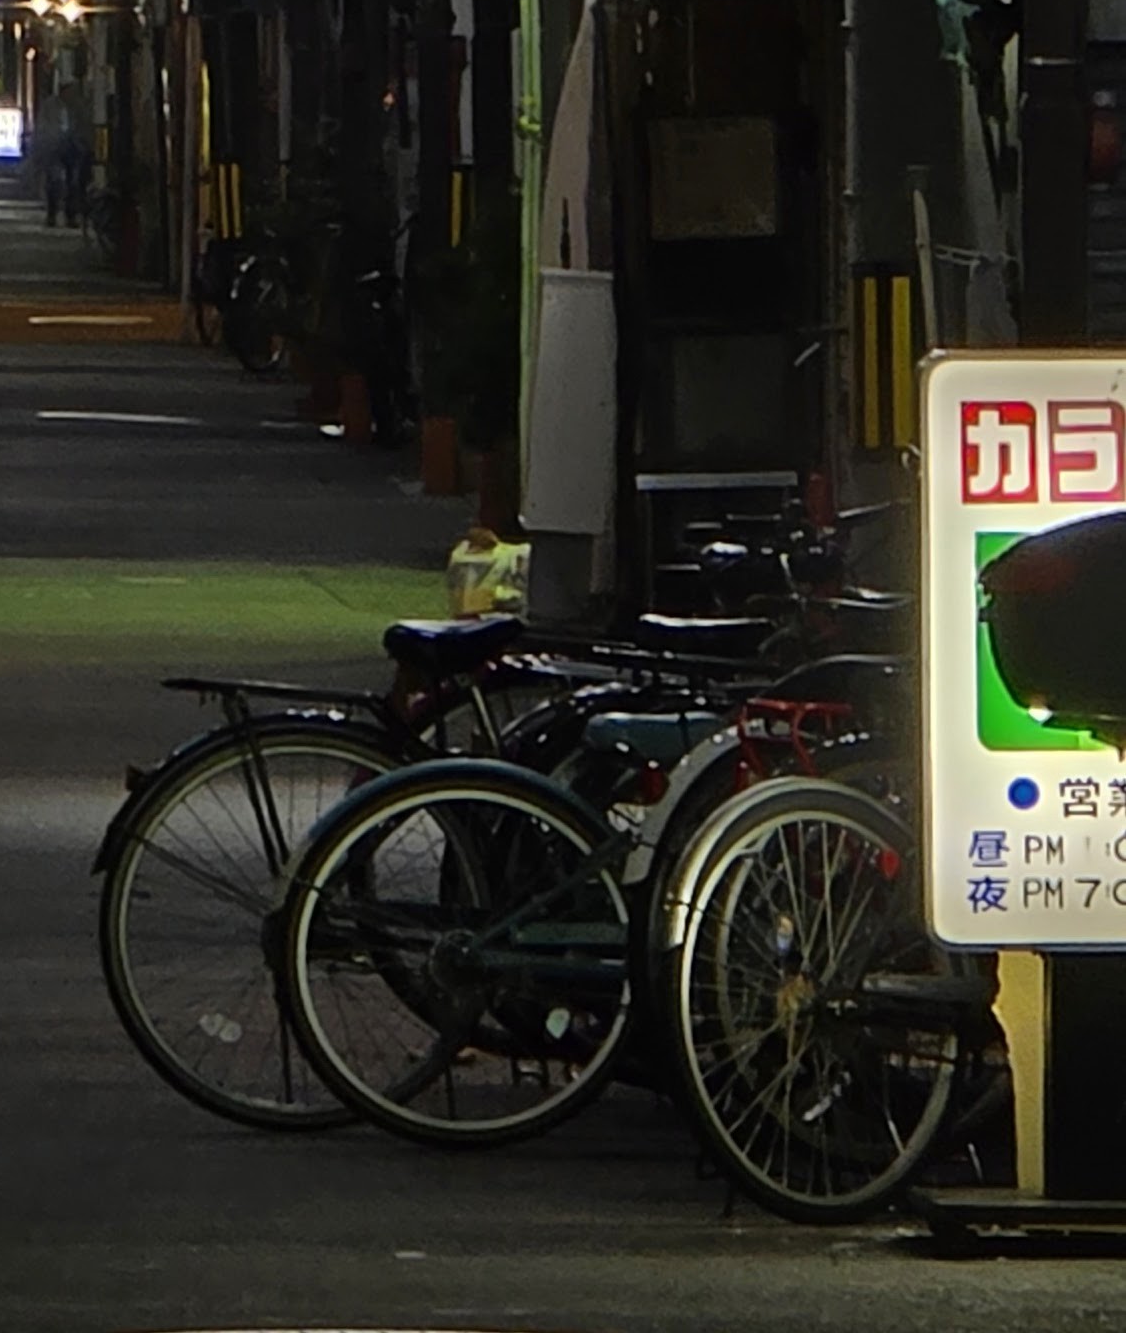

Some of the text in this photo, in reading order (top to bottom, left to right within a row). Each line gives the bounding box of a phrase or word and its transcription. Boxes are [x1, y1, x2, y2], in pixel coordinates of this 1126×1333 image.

[968, 830, 1010, 868] 昼
[1024, 834, 1065, 865] PM
[967, 875, 1010, 914] 夜
[1023, 877, 1064, 910] PM
